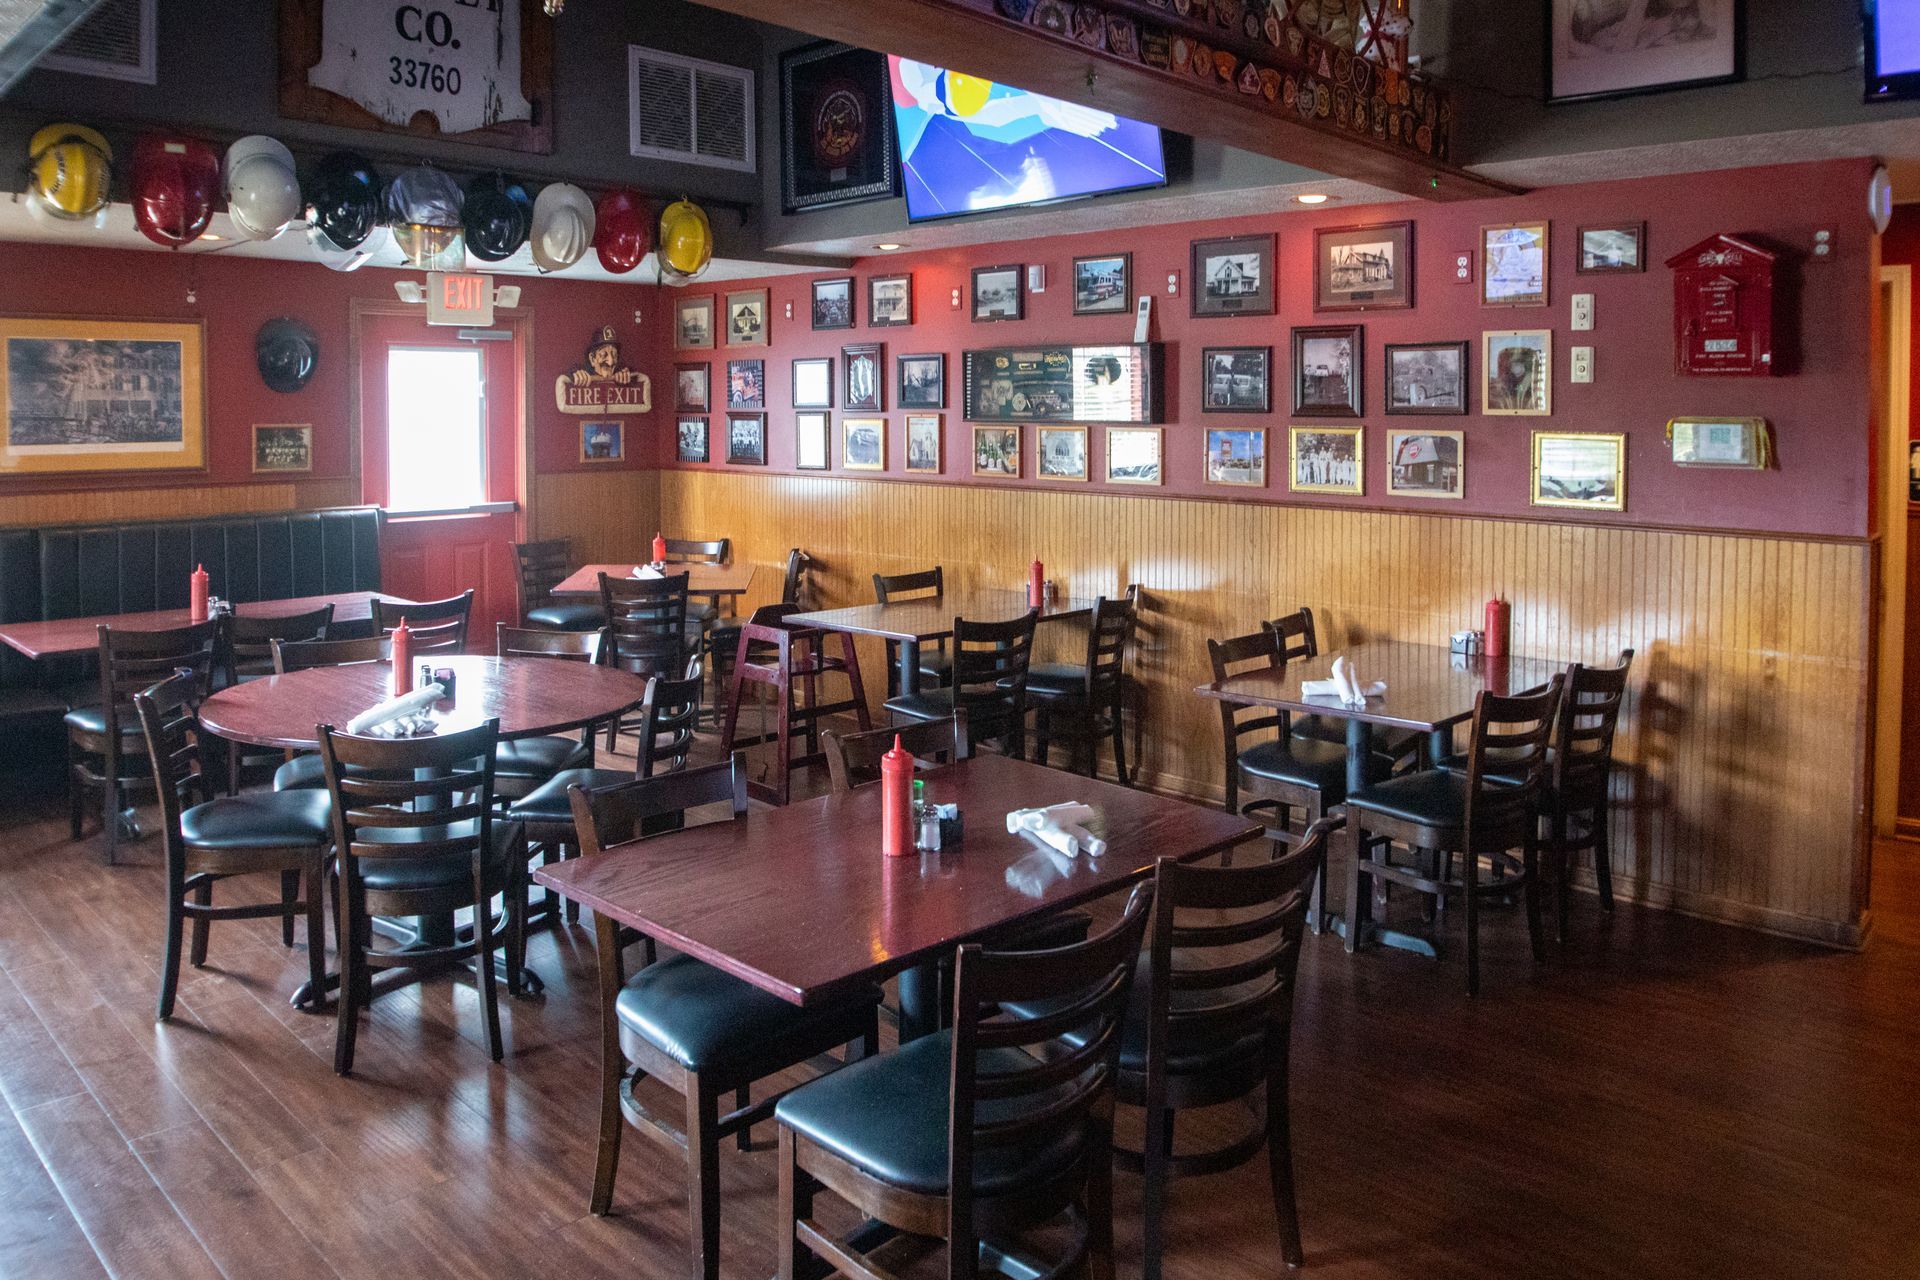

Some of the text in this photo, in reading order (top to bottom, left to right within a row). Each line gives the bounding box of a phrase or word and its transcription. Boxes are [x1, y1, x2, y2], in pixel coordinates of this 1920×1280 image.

[395, 5, 461, 49] CO.
[389, 56, 461, 95] 33760
[444, 276, 484, 310] EXIT
[569, 387, 641, 405] FIRE EXIT
